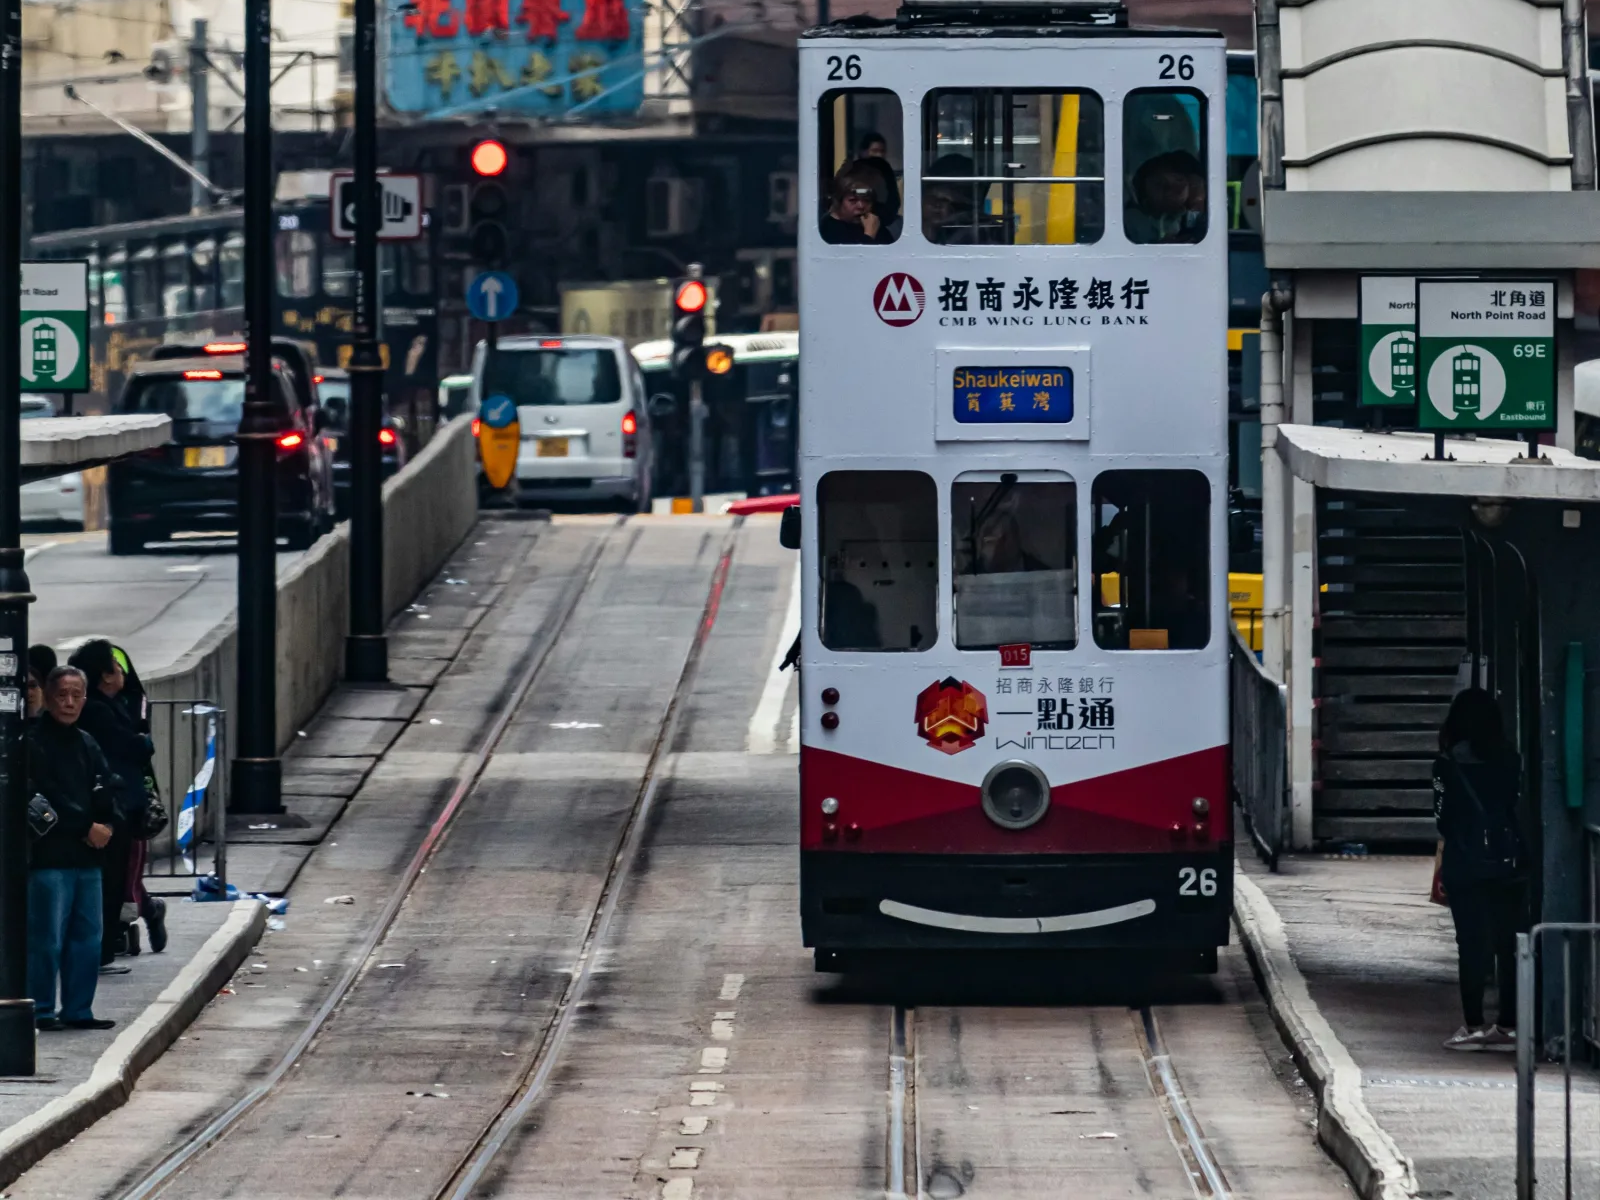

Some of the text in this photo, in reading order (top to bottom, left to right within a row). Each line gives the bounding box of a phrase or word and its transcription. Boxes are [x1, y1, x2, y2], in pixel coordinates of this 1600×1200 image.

[826, 54, 862, 81] 26
[1157, 54, 1195, 81] 26
[938, 276, 1150, 312] 招商永隆銀行
[1490, 290, 1546, 307] 北角道
[1388, 301, 1416, 310] North
[938, 315, 1149, 327] CMB WING LUNG BANK
[1450, 311, 1546, 320] North Point Road
[1513, 344, 1546, 358] 69E
[954, 370, 1064, 388] Shaukeiwan
[966, 391, 1050, 412] 筲箕灣
[1500, 413, 1546, 421] Eastbound
[1003, 648, 1028, 662] 015
[996, 676, 1115, 695] 招商永隆銀行
[996, 697, 1115, 730] 一點通
[1178, 866, 1218, 897] 26
